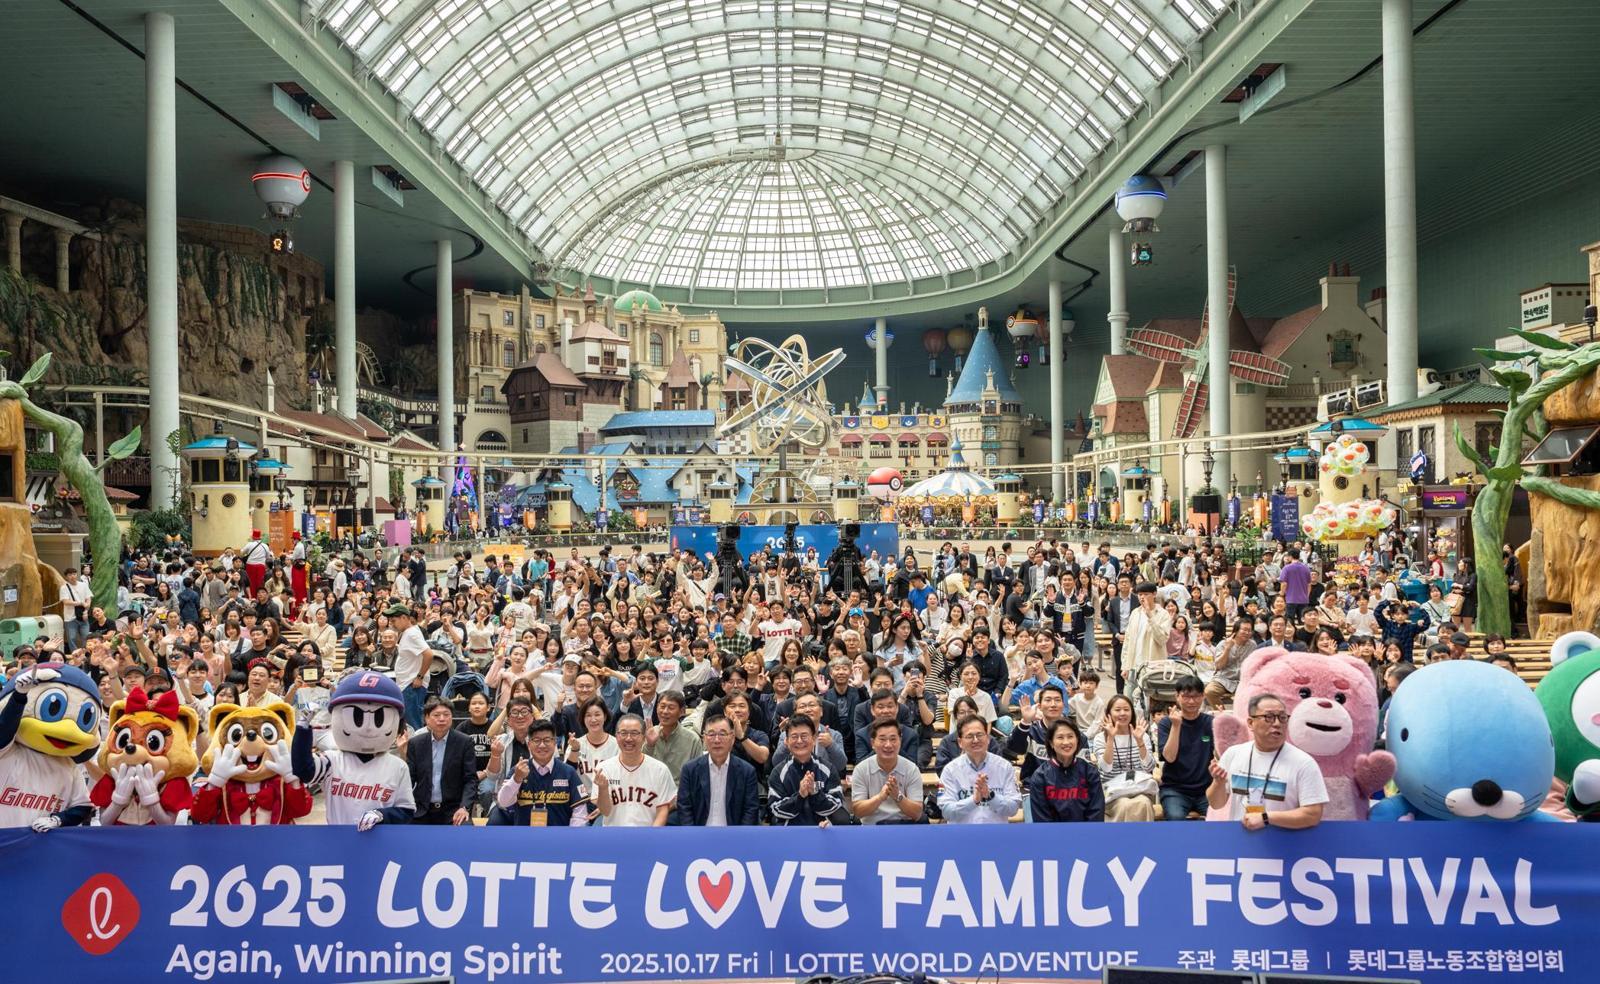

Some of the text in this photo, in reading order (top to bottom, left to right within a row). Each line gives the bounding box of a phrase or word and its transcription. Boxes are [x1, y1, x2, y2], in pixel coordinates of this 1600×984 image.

[767, 629, 792, 637] LOTTE
[0, 787, 65, 813] Giants
[611, 786, 659, 807] BLITZ
[376, 860, 618, 929] LOTTE
[877, 856, 1157, 928] FAMILY
[1186, 857, 1561, 926] FESTIVAL
[165, 941, 563, 981] Again, Winning Spirit
[600, 951, 1138, 973] 2025.10.17 Fri LOTTE WORLD ADVENTURE
[1177, 949, 1565, 972] 주관 롯데그룹 롯데그룹노동조합협의회
